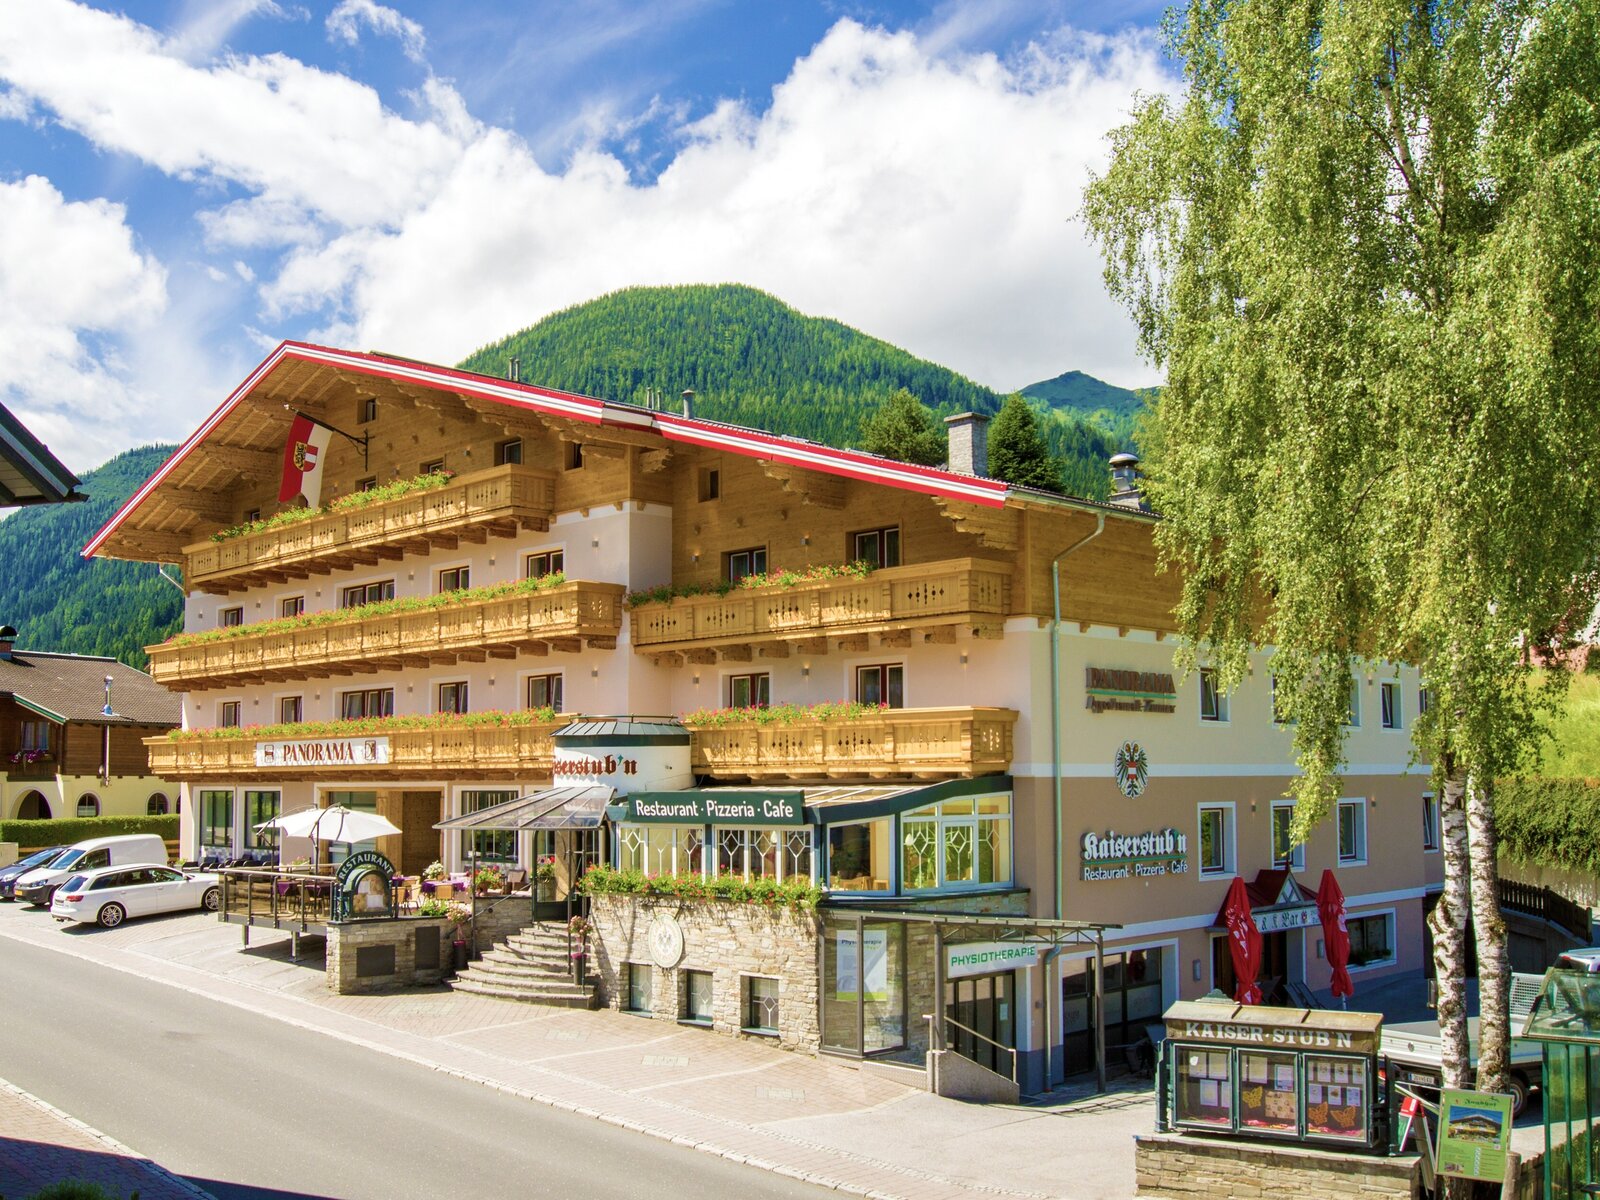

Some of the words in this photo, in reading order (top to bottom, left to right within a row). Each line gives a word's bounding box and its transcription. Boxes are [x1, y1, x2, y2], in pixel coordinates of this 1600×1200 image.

[283, 741, 354, 761] PANORAMA
[553, 754, 637, 775] serstub'n
[635, 799, 699, 816] Restaurant
[706, 799, 755, 818] Pizzeria
[763, 799, 793, 818] Cafe
[1084, 828, 1187, 860] Kaiserstub'n
[339, 854, 394, 879] RESTAURANT
[1084, 865, 1129, 881] Restaurant
[1135, 862, 1165, 877] Pizzeria
[951, 946, 1035, 967] PHYSIOTHERAPIE
